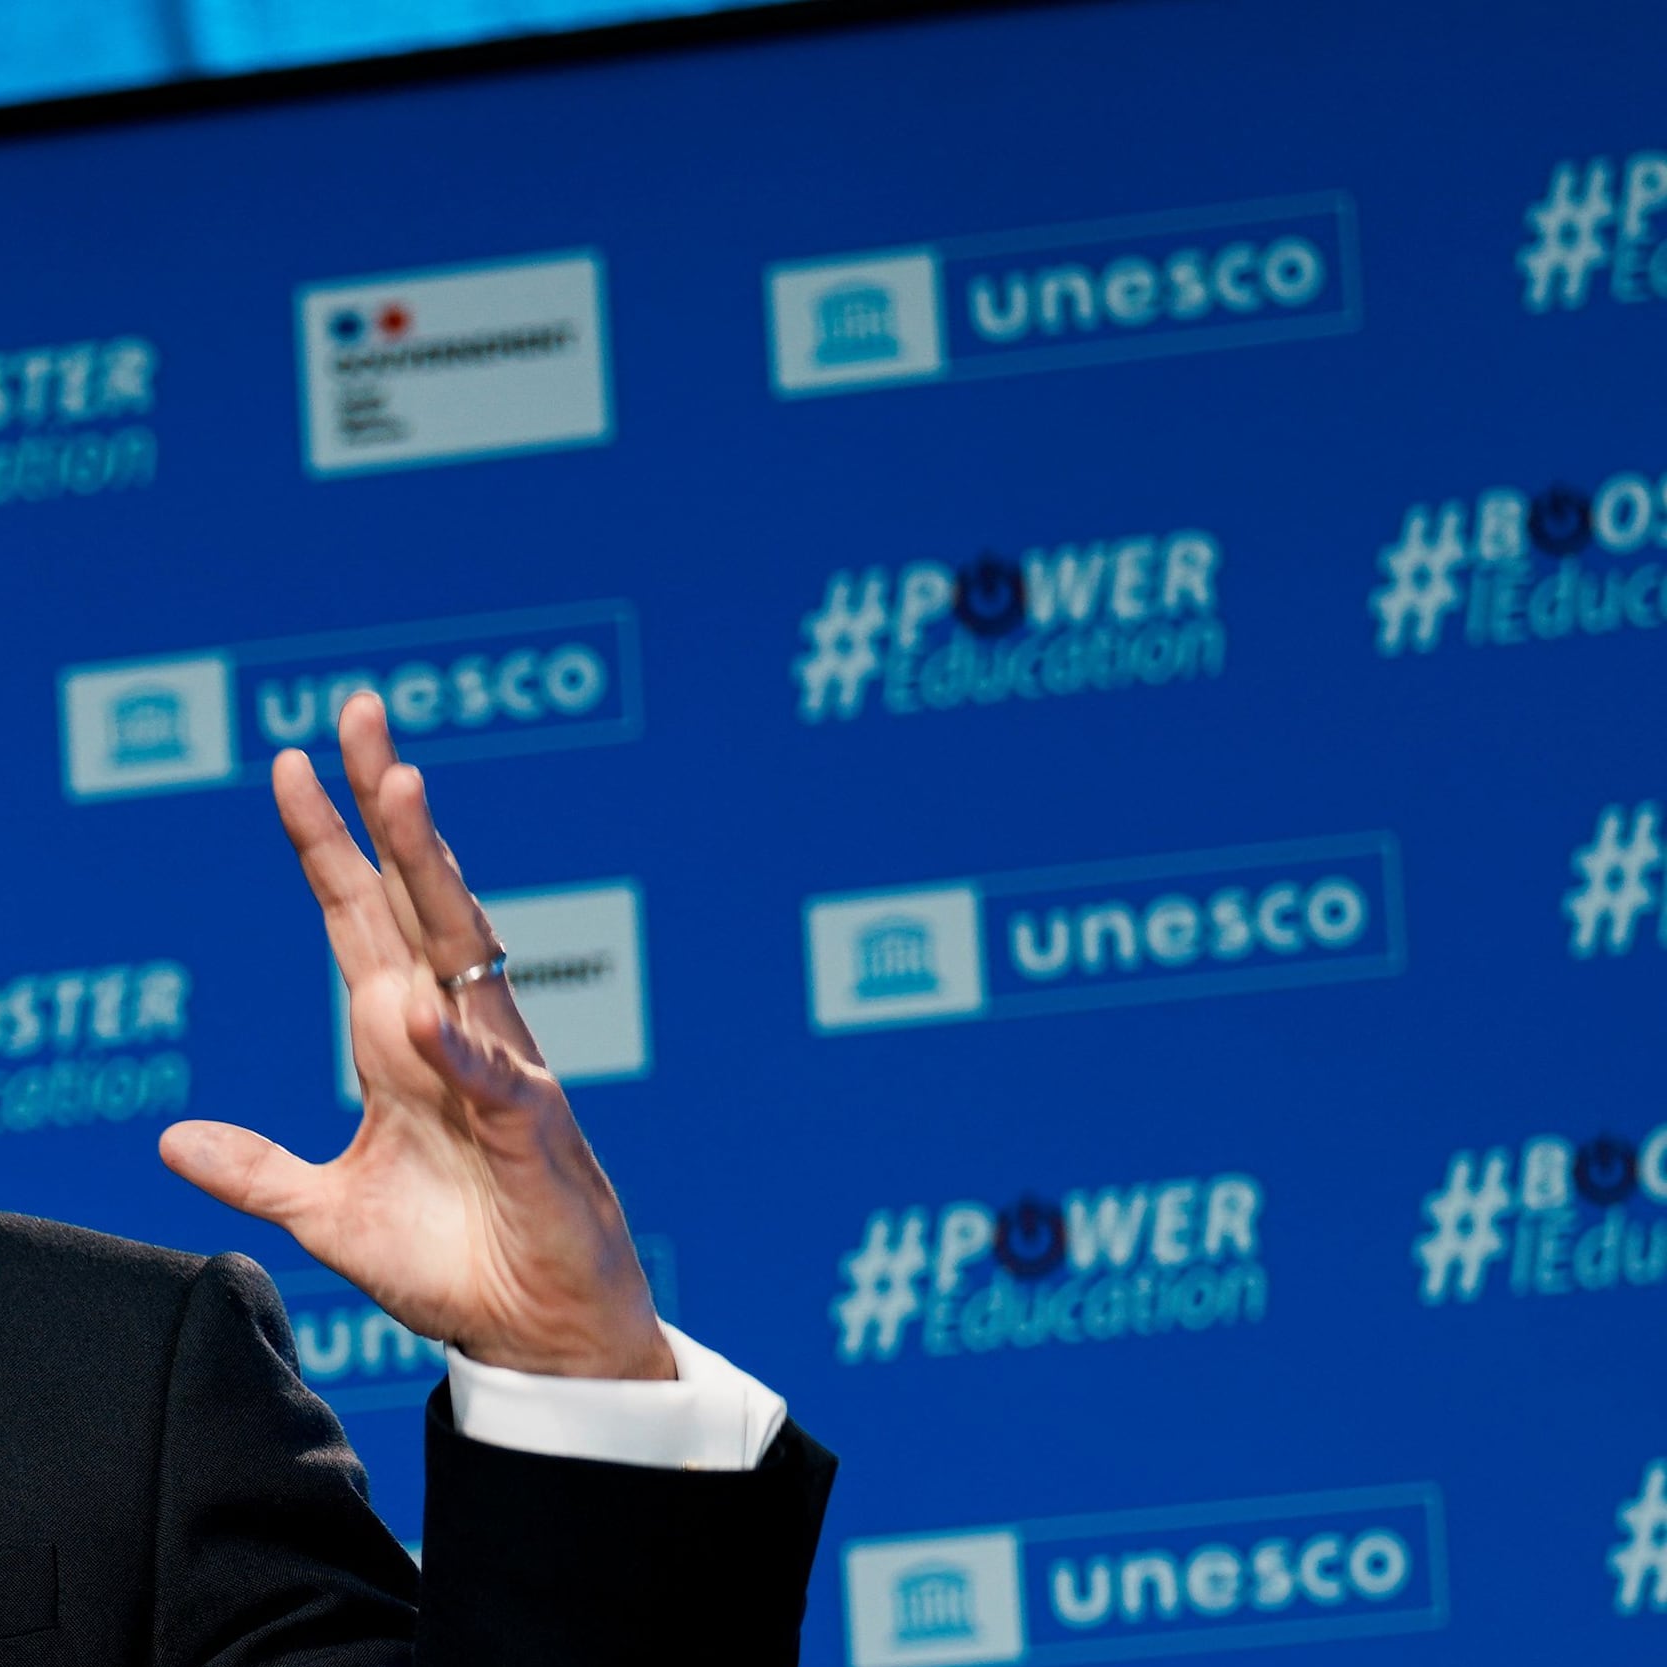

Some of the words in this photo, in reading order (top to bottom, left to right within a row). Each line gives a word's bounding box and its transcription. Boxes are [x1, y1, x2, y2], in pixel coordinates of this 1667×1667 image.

[971, 240, 1320, 337] unesco
[886, 621, 1225, 709] Education
[1013, 880, 1365, 976] unesco
[925, 1260, 1264, 1353] Education
[1054, 1532, 1406, 1625] unesco
